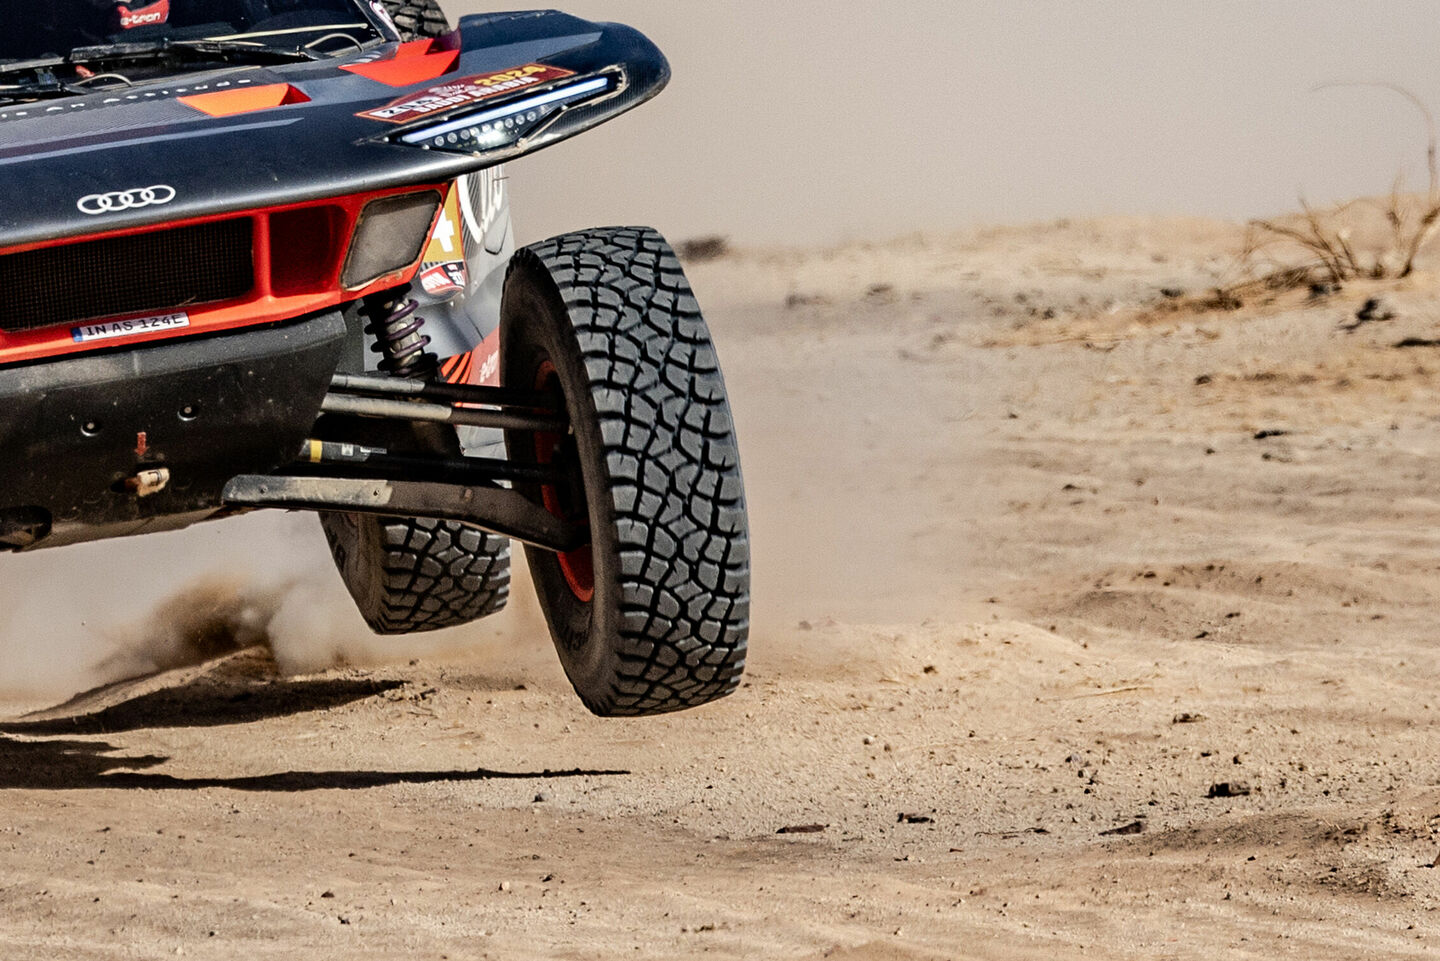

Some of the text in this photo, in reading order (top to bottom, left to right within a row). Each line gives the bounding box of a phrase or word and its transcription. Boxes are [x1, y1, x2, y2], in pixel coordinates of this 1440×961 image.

[120, 12, 161, 26] e-tron
[473, 65, 548, 87] 2024
[411, 91, 470, 113] SAUDI
[469, 75, 540, 97] ARABIA
[86, 313, 185, 337] IN AS 124E
